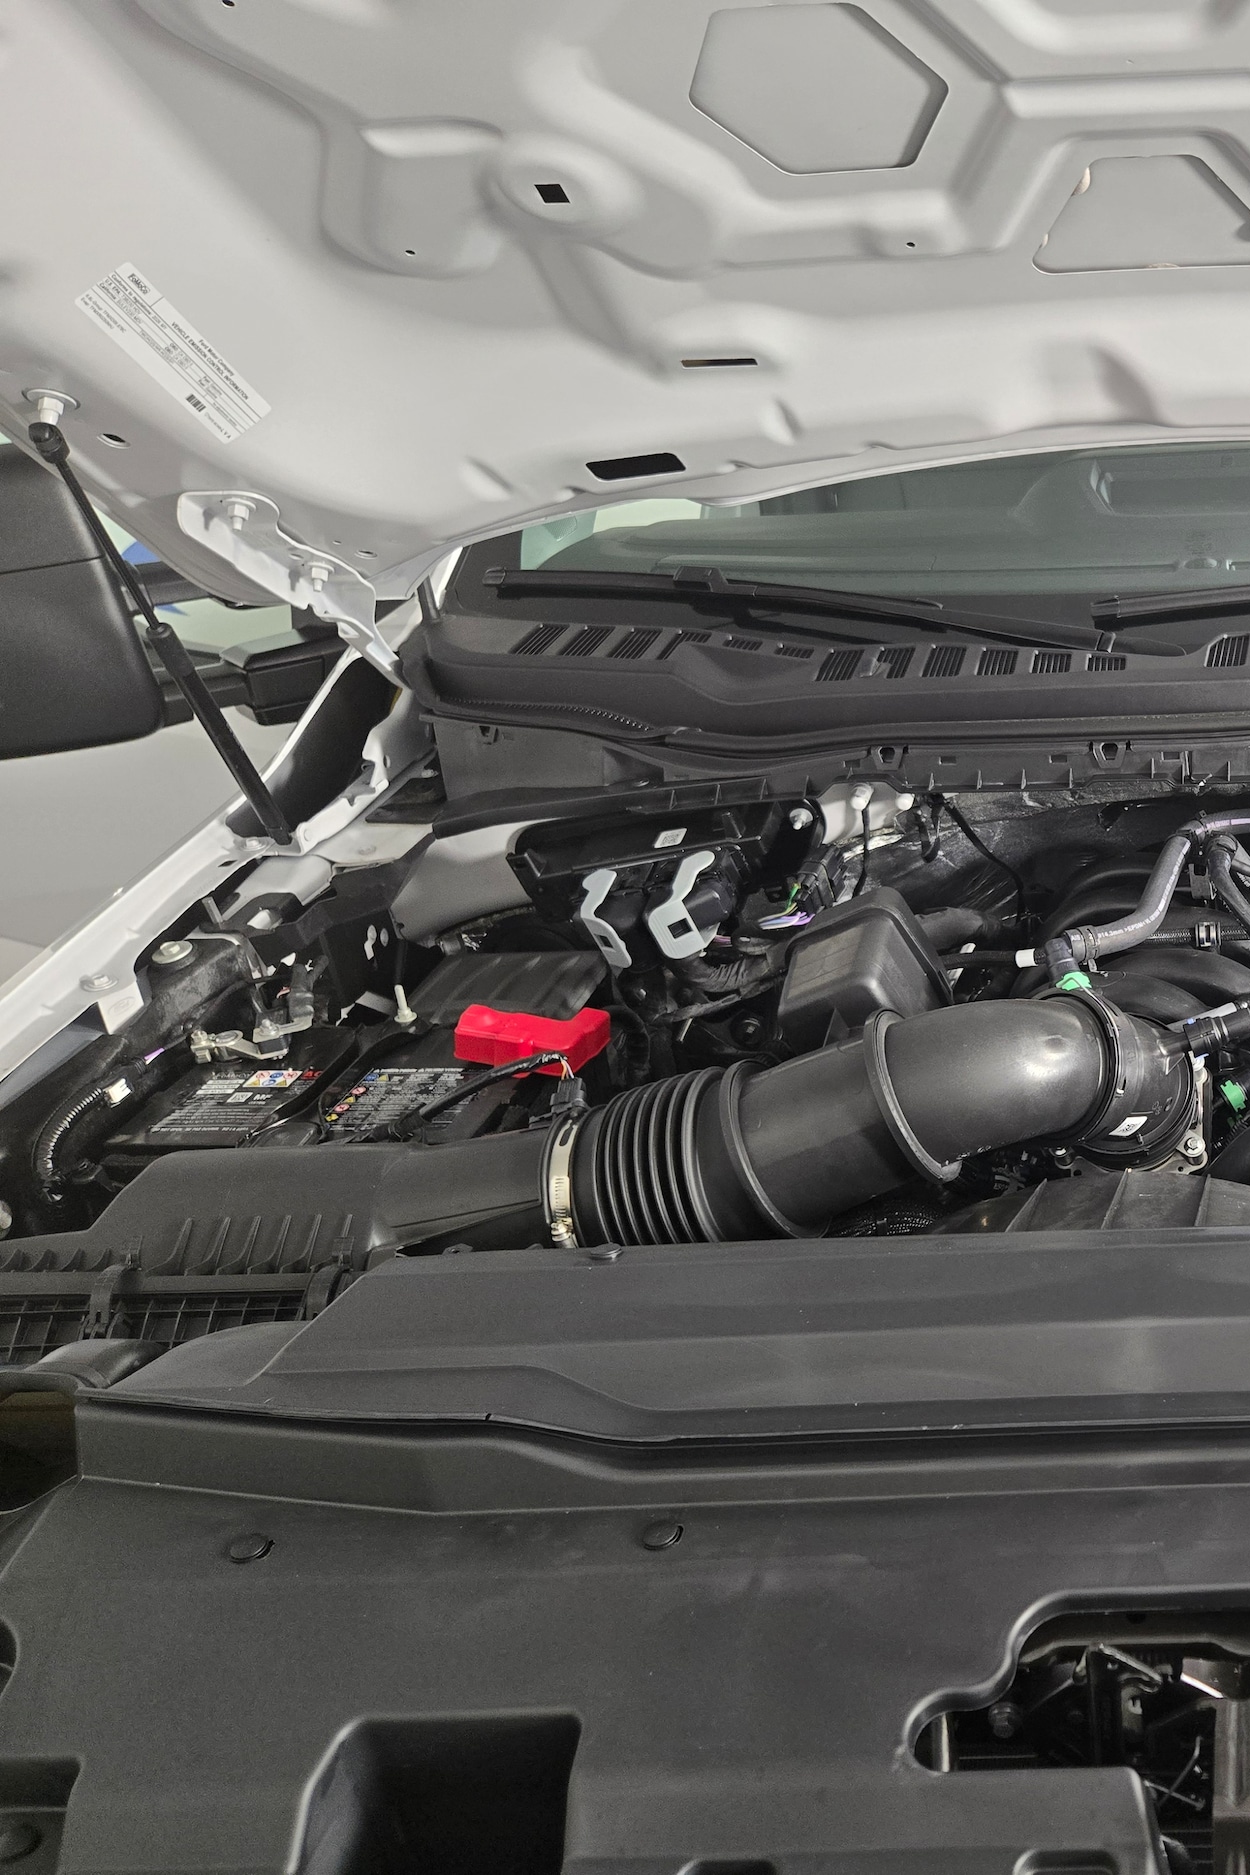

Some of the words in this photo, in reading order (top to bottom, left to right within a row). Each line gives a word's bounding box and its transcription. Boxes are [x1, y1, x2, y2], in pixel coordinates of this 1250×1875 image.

[110, 273, 129, 291] Conforms
[127, 272, 151, 295] FoMoCo
[170, 321, 190, 340] VEHICLE
[187, 338, 208, 358] EMISSION
[205, 357, 225, 375] CONTROL
[223, 374, 249, 400] INFORMATION
[198, 339, 209, 349] Ford
[206, 347, 219, 359] Motor
[216, 358, 236, 377] Company
